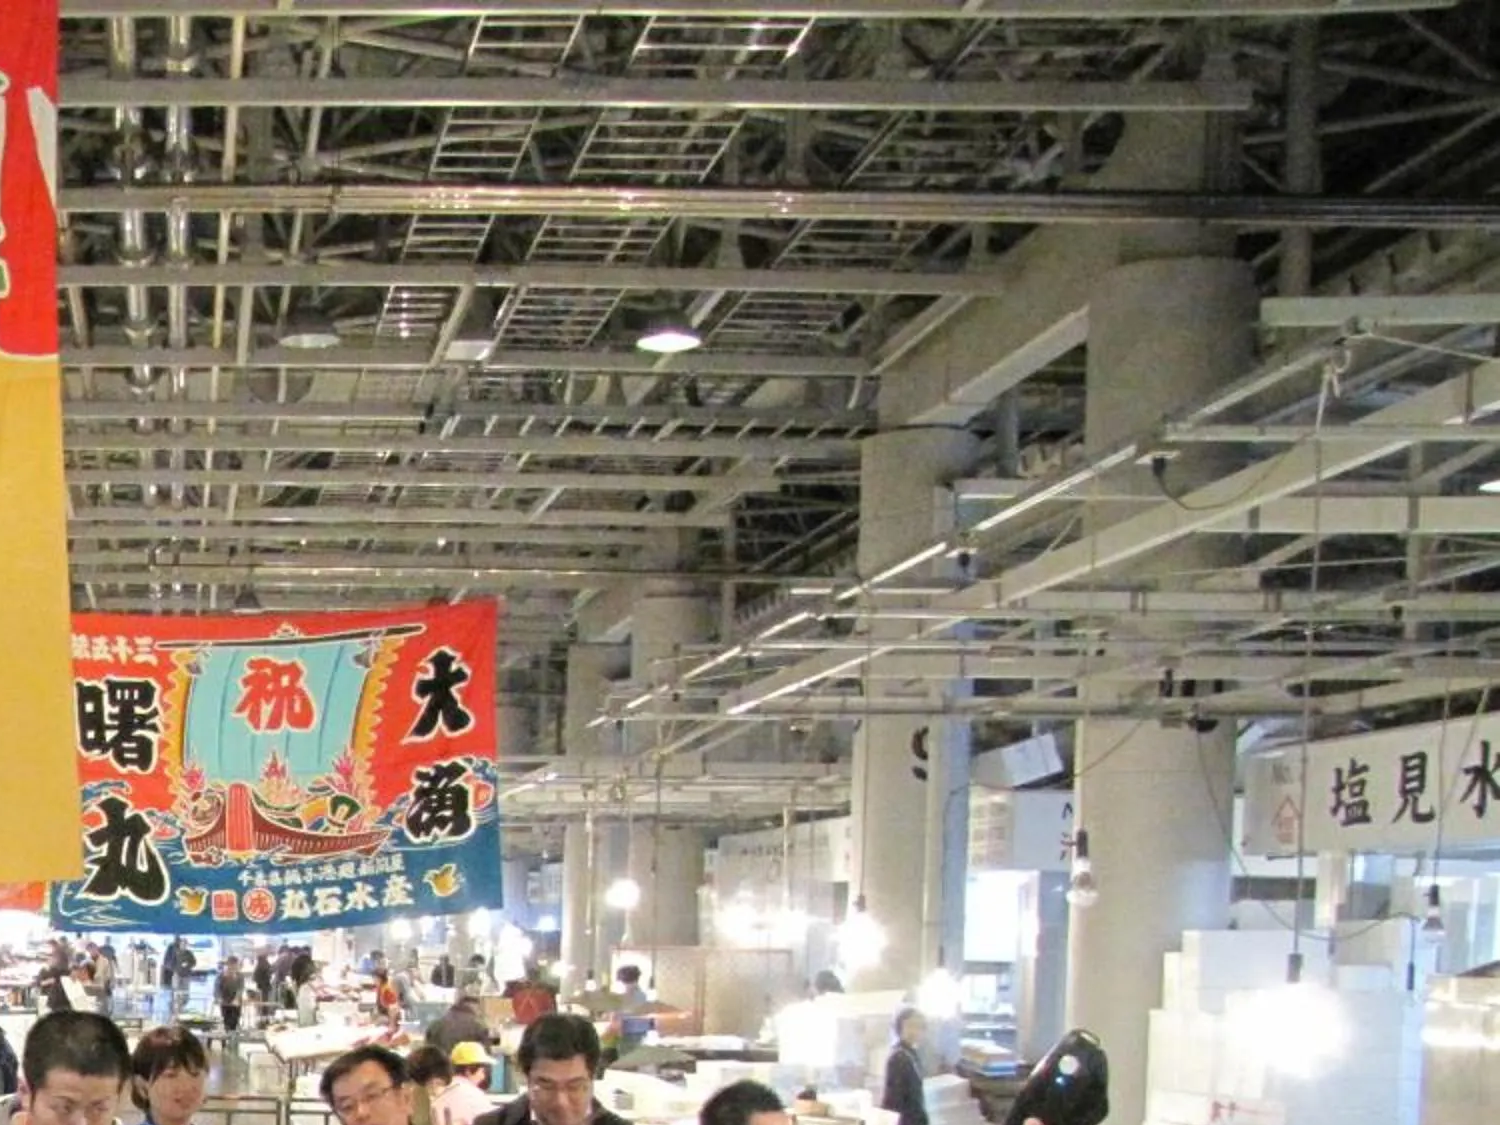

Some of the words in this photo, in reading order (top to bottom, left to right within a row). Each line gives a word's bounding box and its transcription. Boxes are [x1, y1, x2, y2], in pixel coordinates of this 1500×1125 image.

[231, 655, 317, 732] 祝
[401, 646, 477, 844] 大漁
[74, 676, 171, 905] 曙丸
[280, 874, 415, 920] 丸石水産
